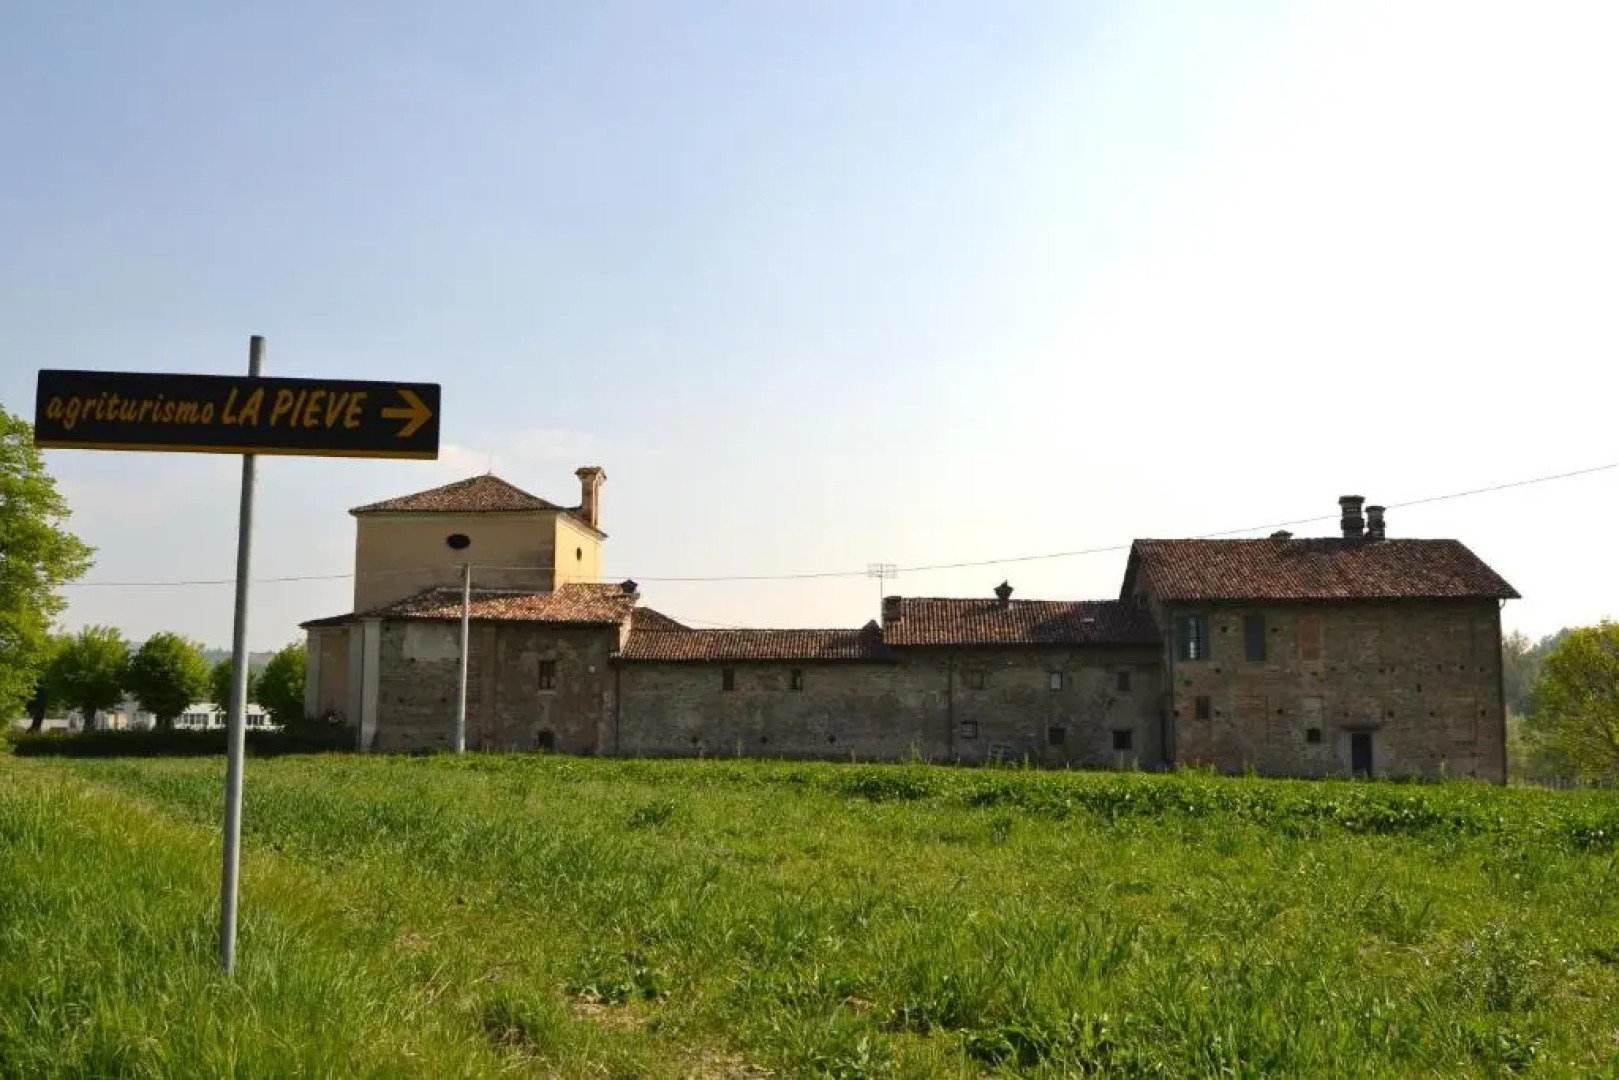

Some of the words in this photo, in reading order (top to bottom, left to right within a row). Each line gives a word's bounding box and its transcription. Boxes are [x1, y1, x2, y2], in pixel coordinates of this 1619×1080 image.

[46, 391, 215, 431] agriturismo
[221, 388, 263, 426] LA
[272, 390, 367, 431] PIEVE
